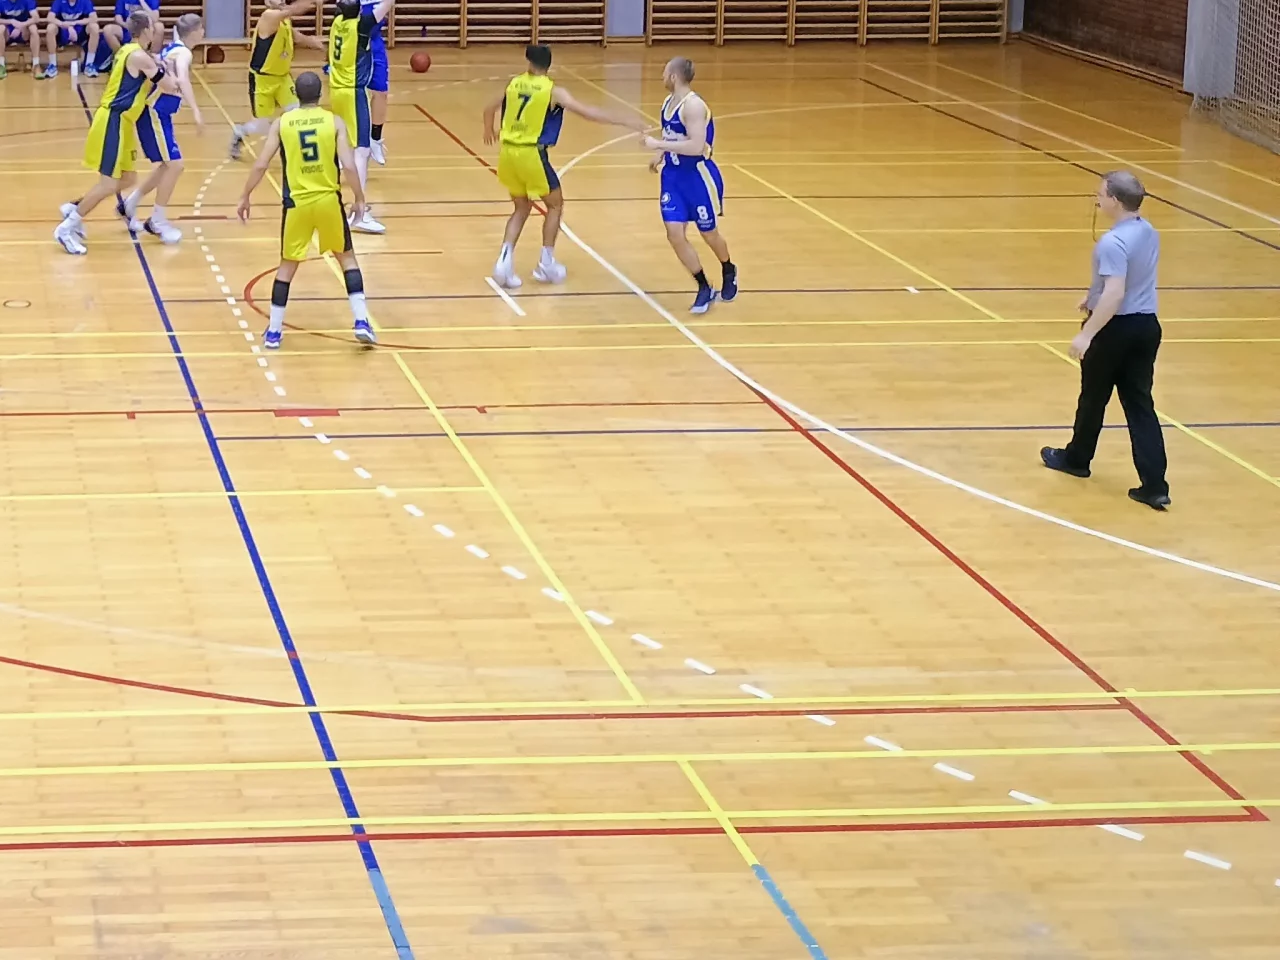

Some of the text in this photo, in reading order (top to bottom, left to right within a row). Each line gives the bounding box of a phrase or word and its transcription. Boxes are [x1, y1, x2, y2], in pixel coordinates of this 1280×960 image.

[517, 93, 531, 121] 7
[298, 129, 319, 161] 5
[697, 205, 709, 220] 8
